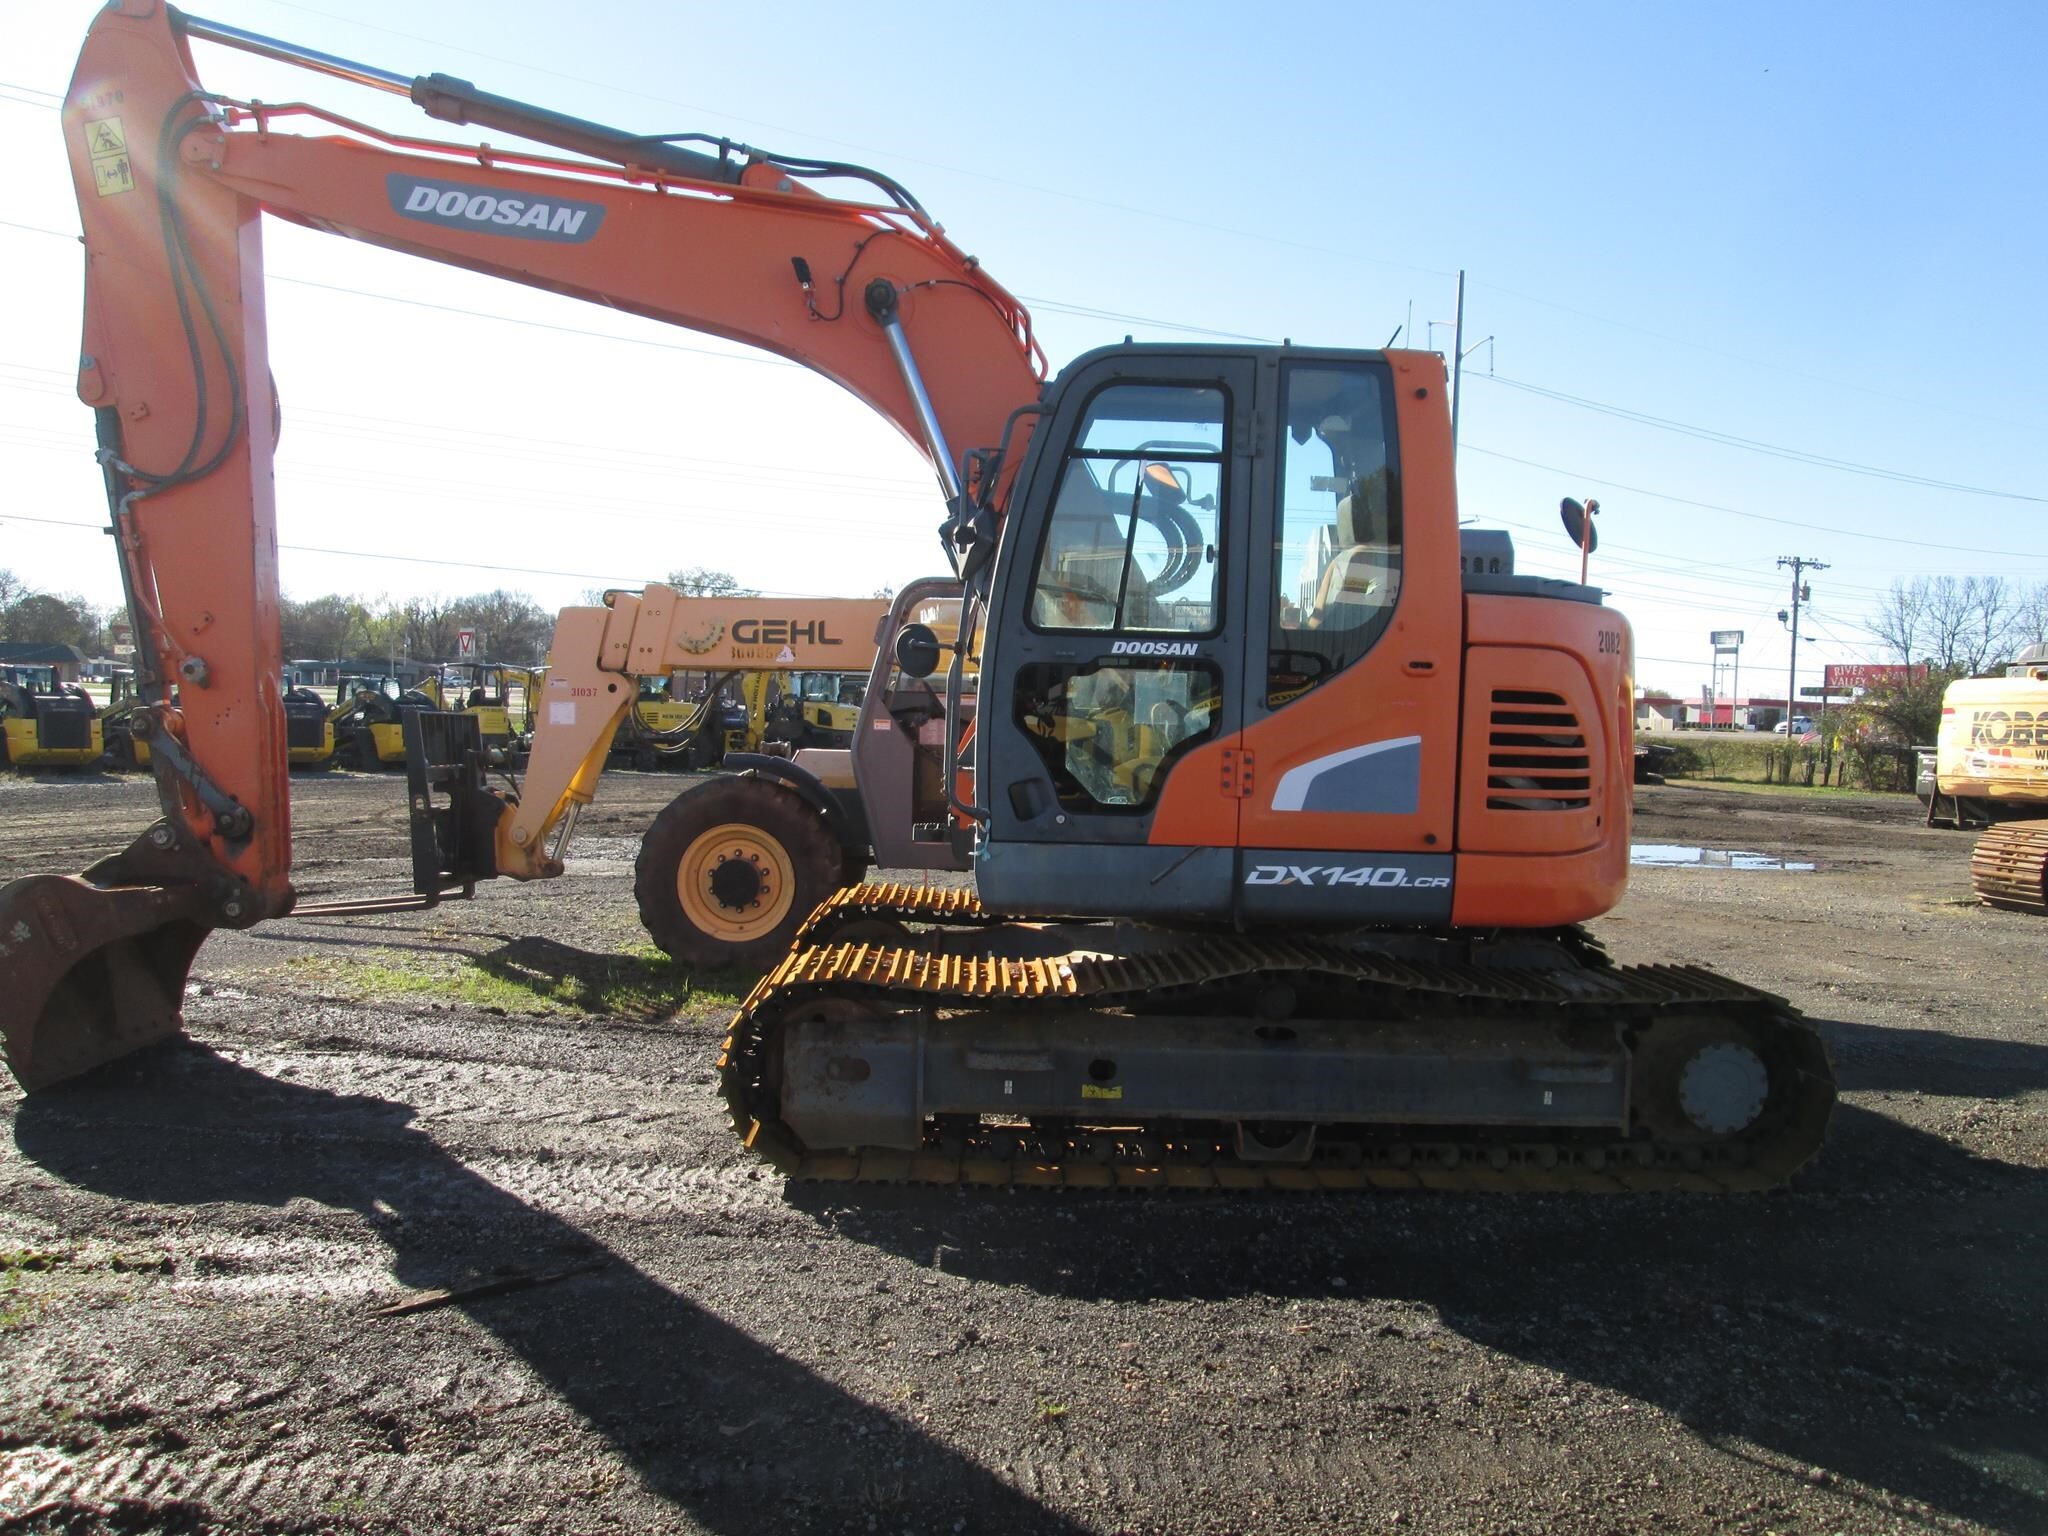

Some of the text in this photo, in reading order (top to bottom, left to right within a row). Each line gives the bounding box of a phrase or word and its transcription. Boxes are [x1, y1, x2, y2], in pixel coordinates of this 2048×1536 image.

[404, 186, 587, 235] DOOSAN
[731, 619, 843, 645] GEHL
[1111, 641, 1199, 655] DOOSAN
[1834, 665, 1865, 677] RIVER
[1831, 677, 1867, 687] VALLEY
[570, 687, 599, 697] 31037
[1245, 865, 1450, 888] DX140LCR
